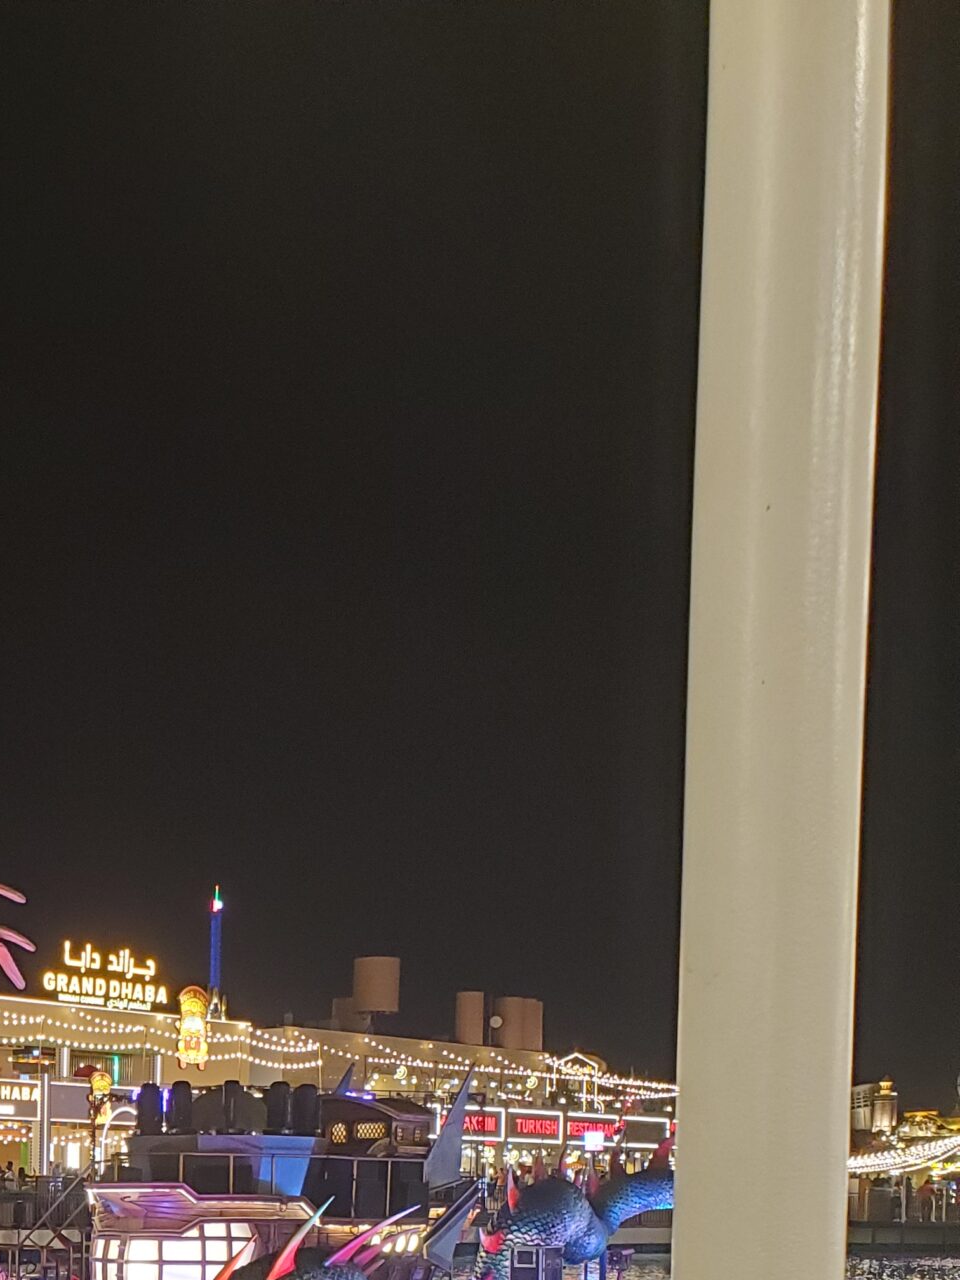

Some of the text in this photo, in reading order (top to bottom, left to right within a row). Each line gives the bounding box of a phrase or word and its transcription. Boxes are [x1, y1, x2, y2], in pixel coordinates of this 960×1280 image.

[43, 971, 107, 996] GRAND
[108, 980, 167, 1004] DHABA
[463, 1116, 617, 1138] AKSIM TURKISH RESTAURAN
